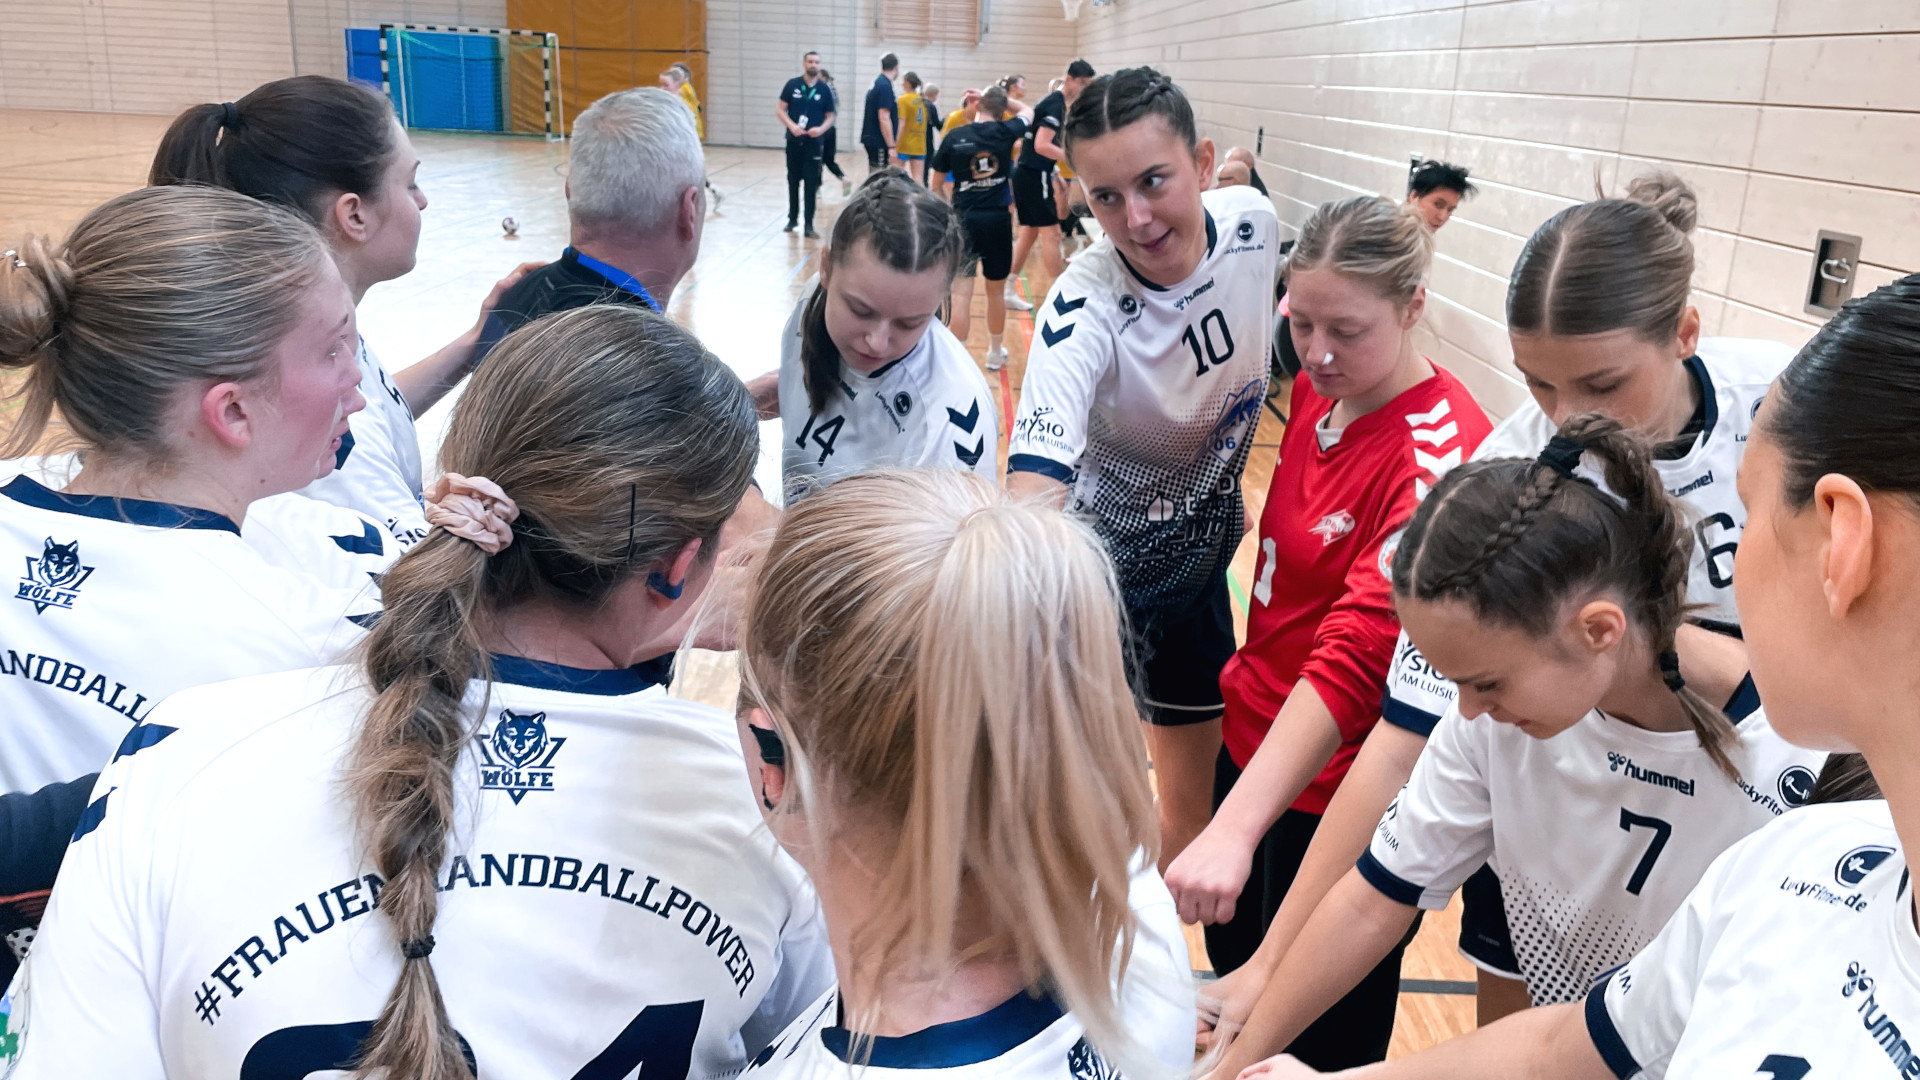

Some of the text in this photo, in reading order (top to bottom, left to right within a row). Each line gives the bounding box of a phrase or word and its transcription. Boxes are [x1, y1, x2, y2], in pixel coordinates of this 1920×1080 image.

[1183, 277, 1215, 304] hummel
[1182, 308, 1235, 378] 10
[795, 414, 846, 466] 14
[1213, 436, 1236, 451] 06
[1669, 469, 1714, 498] ummel
[1695, 512, 1739, 589] 6
[18, 581, 78, 606] WÖLFE
[0, 649, 148, 723] NDBALL
[1400, 672, 1457, 702] AM LUISIU
[481, 767, 553, 787] WÖLFE
[1624, 759, 1695, 797] hummel
[1619, 806, 1672, 896] 7
[195, 852, 757, 1027] #FRAUENANDBALLPOWER
